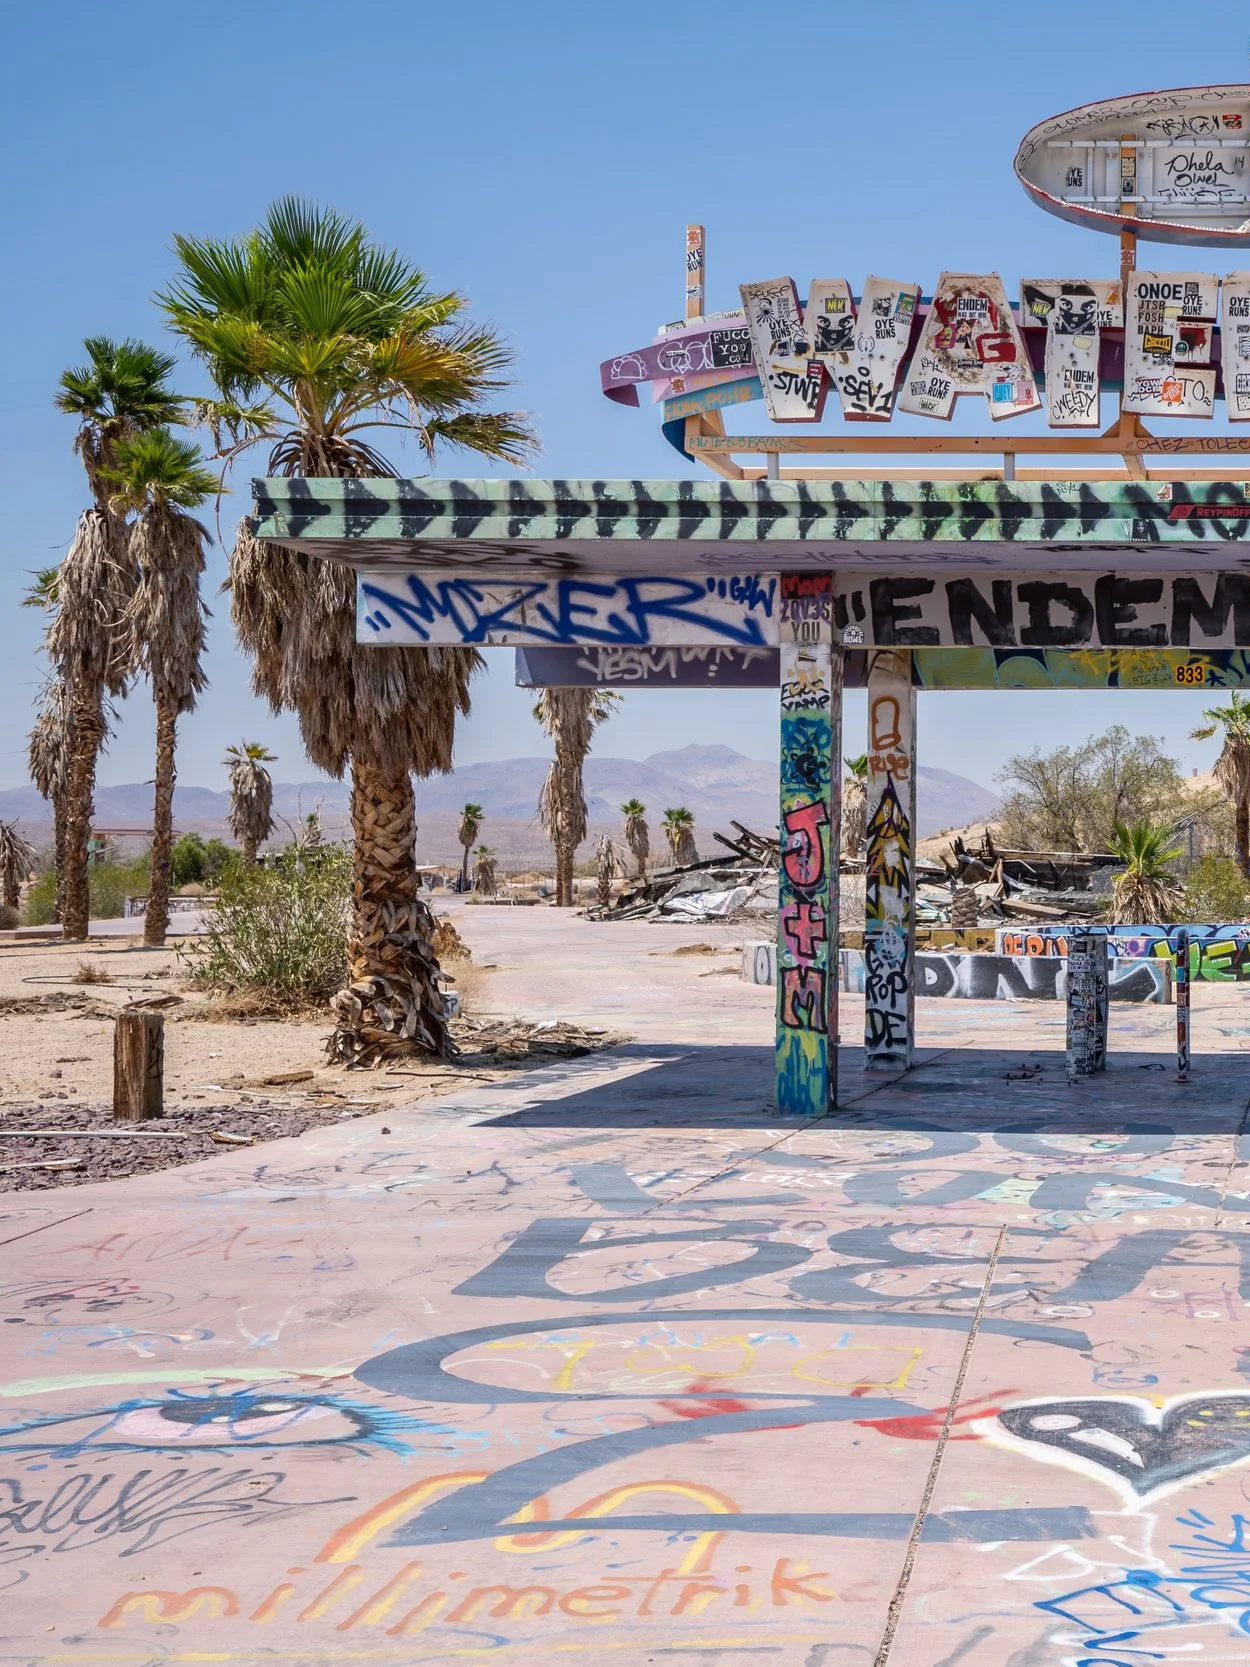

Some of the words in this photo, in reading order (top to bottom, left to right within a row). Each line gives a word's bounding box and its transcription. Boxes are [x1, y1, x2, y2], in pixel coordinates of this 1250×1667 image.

[1137, 283, 1183, 300] ONOE
[958, 298, 988, 312] ENDEM
[1138, 300, 1166, 310] JTSR
[1183, 296, 1203, 306] OYE
[1229, 297, 1250, 307] OYE
[1138, 312, 1164, 322] FOSH
[1182, 305, 1203, 316] RUNS
[1229, 306, 1250, 317] RUNS
[874, 318, 895, 330] OYE
[770, 326, 791, 341] RUNS
[875, 328, 896, 340] RUNS
[719, 343, 747, 357] YOU
[931, 377, 951, 392] OYE
[791, 621, 821, 642] YOU
[1176, 665, 1205, 684] 833
[97, 1557, 838, 1637] millimetrik
